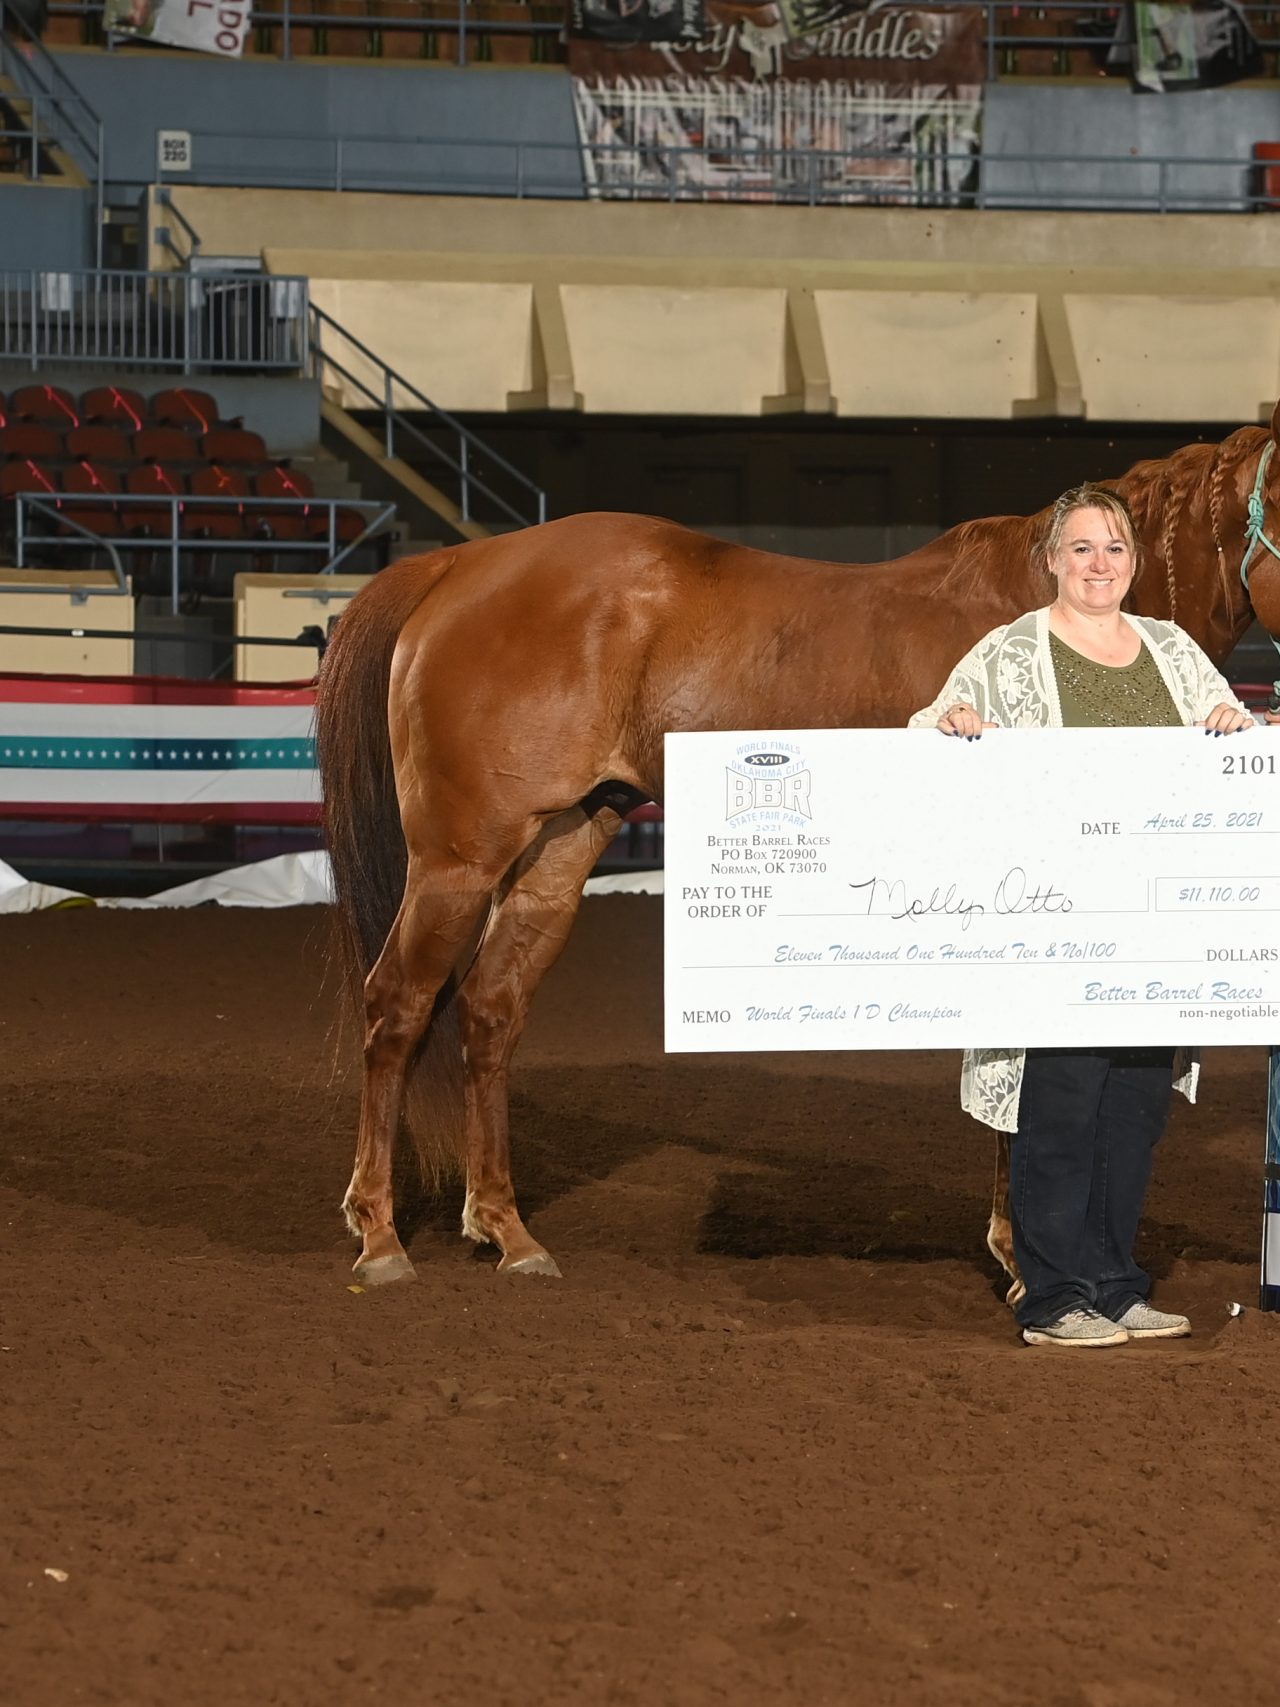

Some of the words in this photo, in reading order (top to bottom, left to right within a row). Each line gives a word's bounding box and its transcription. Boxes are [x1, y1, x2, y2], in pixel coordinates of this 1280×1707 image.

[214, 0, 243, 51] DO
[163, 139, 186, 149] BOX
[736, 741, 767, 755] WORLD
[770, 741, 801, 755] FINALS
[750, 755, 783, 765] XVIII
[1222, 755, 1276, 774] 2101
[731, 759, 782, 779] OKLAHOMA
[786, 759, 806, 775] CITY
[725, 766, 812, 821] BBR
[729, 812, 756, 829] STATE
[760, 811, 780, 821] FAIR
[783, 812, 807, 829] PARK
[755, 824, 782, 832] 2021
[1081, 822, 1121, 835] DATE
[1143, 812, 1187, 832] April
[1226, 811, 1264, 827] 2021
[721, 849, 740, 860] PO
[772, 848, 817, 860] 720900
[765, 862, 785, 874] OK
[790, 862, 827, 873] 73070
[682, 887, 710, 900] PAY
[714, 886, 736, 899] TO
[741, 885, 773, 899] THE
[849, 876, 985, 931] Molly
[994, 866, 1073, 915] Otto
[687, 905, 741, 918] ORDER
[746, 904, 767, 918] OF
[774, 945, 823, 963] Eleven
[828, 943, 901, 961] Thousand
[906, 944, 935, 960] One
[939, 943, 1005, 960] Hundred
[1011, 942, 1039, 959] Ten
[1045, 942, 1057, 958] &
[1207, 948, 1279, 962] DOLLARS
[1084, 982, 1137, 1001] Better
[1145, 981, 1204, 1001] Barrel
[1211, 981, 1264, 1001] Races
[682, 1010, 731, 1024] MEMO
[745, 1005, 793, 1021] World
[798, 1004, 848, 1023] Finals
[866, 1004, 881, 1020] D
[888, 1003, 963, 1023] Champion
[1179, 1006, 1279, 1021] non-negotiable
